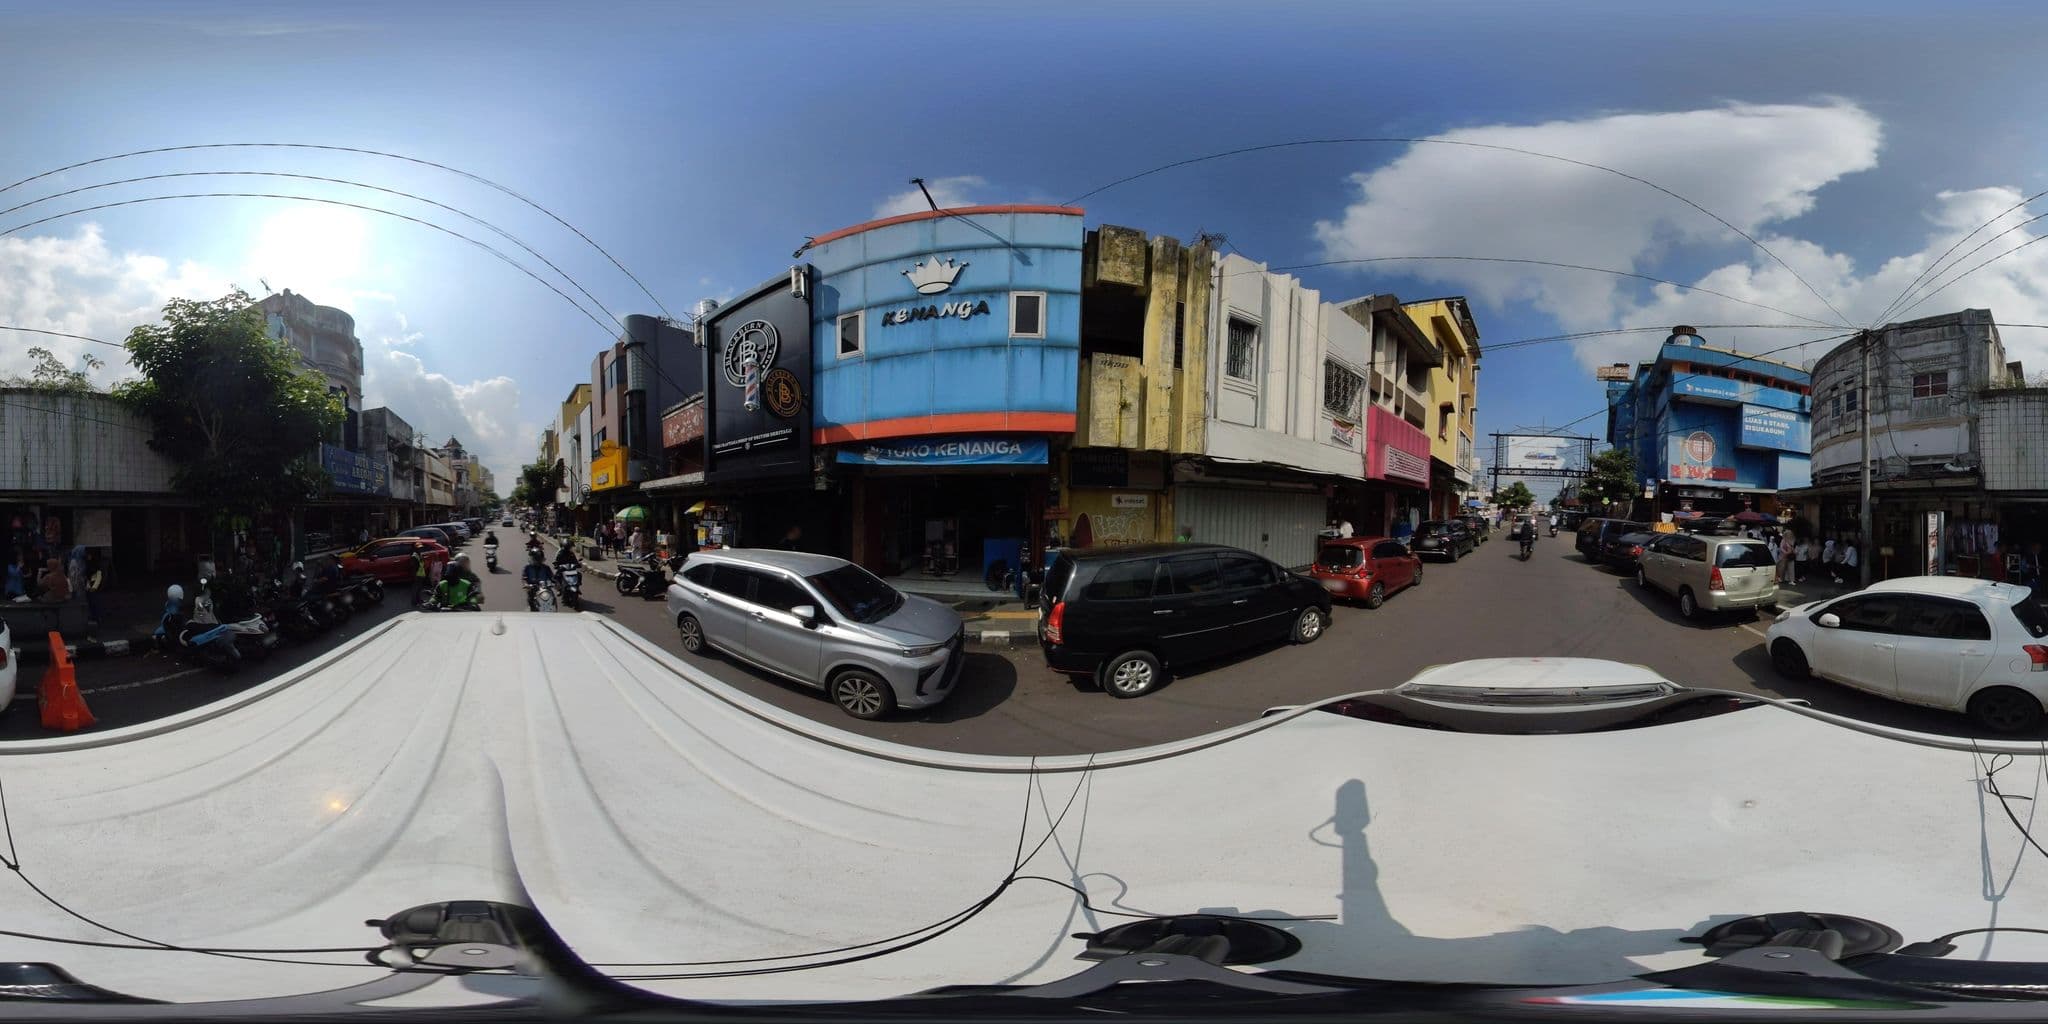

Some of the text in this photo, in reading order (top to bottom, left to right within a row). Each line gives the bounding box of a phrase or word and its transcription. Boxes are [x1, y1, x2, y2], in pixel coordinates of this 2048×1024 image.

[881, 300, 990, 327] KENANGA
[725, 321, 763, 366] BLACKBURN
[886, 441, 1022, 458] TOKO KENANGA
